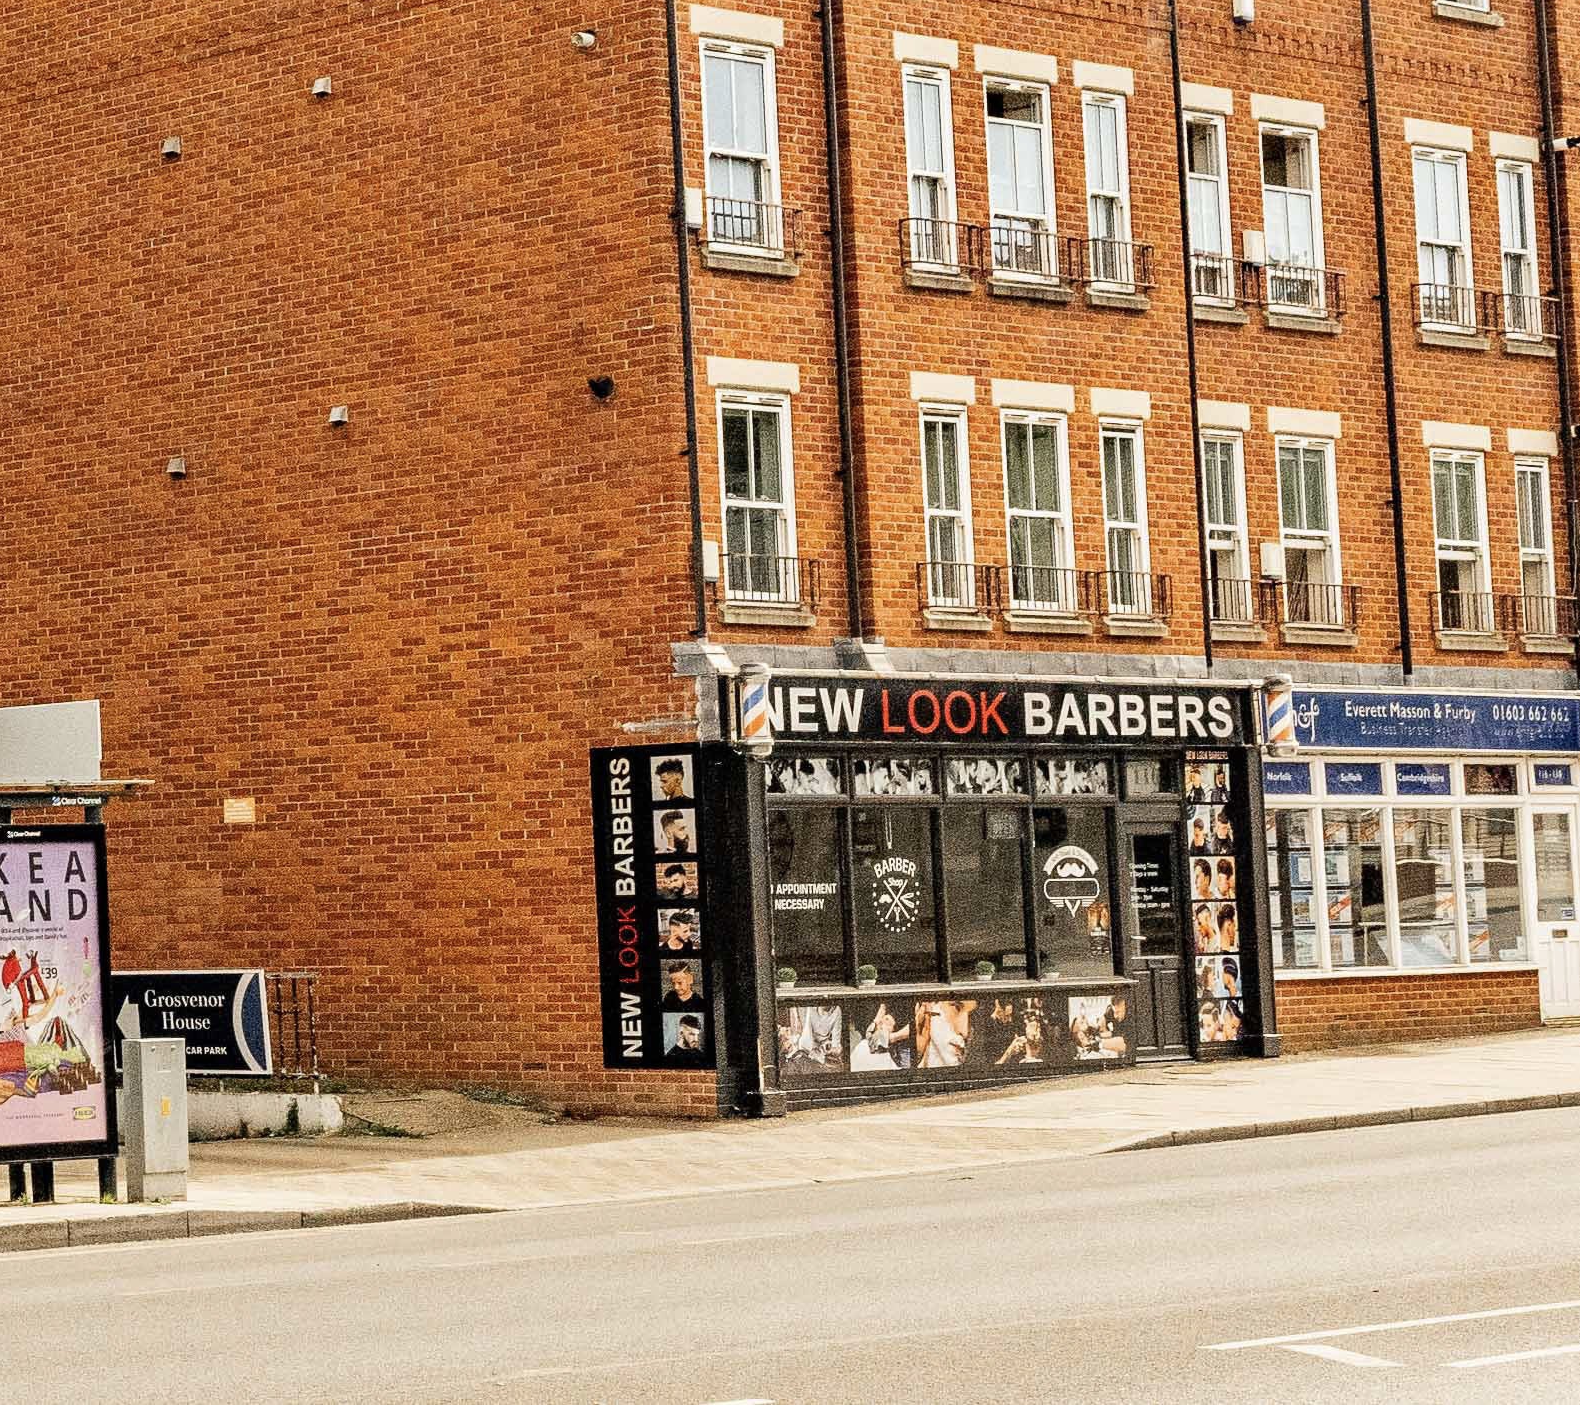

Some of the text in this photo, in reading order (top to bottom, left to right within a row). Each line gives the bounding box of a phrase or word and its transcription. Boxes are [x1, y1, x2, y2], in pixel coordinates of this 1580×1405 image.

[767, 686, 864, 732] NEW
[881, 689, 1010, 735] LOOK
[1024, 693, 1235, 738] BARBERS
[1344, 700, 1476, 724] Everett Masson & Furby
[1492, 704, 1525, 721] 01603
[1528, 705, 1547, 722] 662
[1266, 772, 1292, 783] Norfolk
[1396, 772, 1445, 785] Cambridgeshire
[874, 857, 917, 878] BARBER
[776, 882, 837, 895] APPOINTMENT
[609, 757, 644, 1058] NEW LOOK BARBERS
[774, 898, 825, 911] NECESSARY
[144, 989, 226, 1008] Grosvenor
[161, 1011, 211, 1030] House
[185, 1046, 228, 1055] CAR PARK
